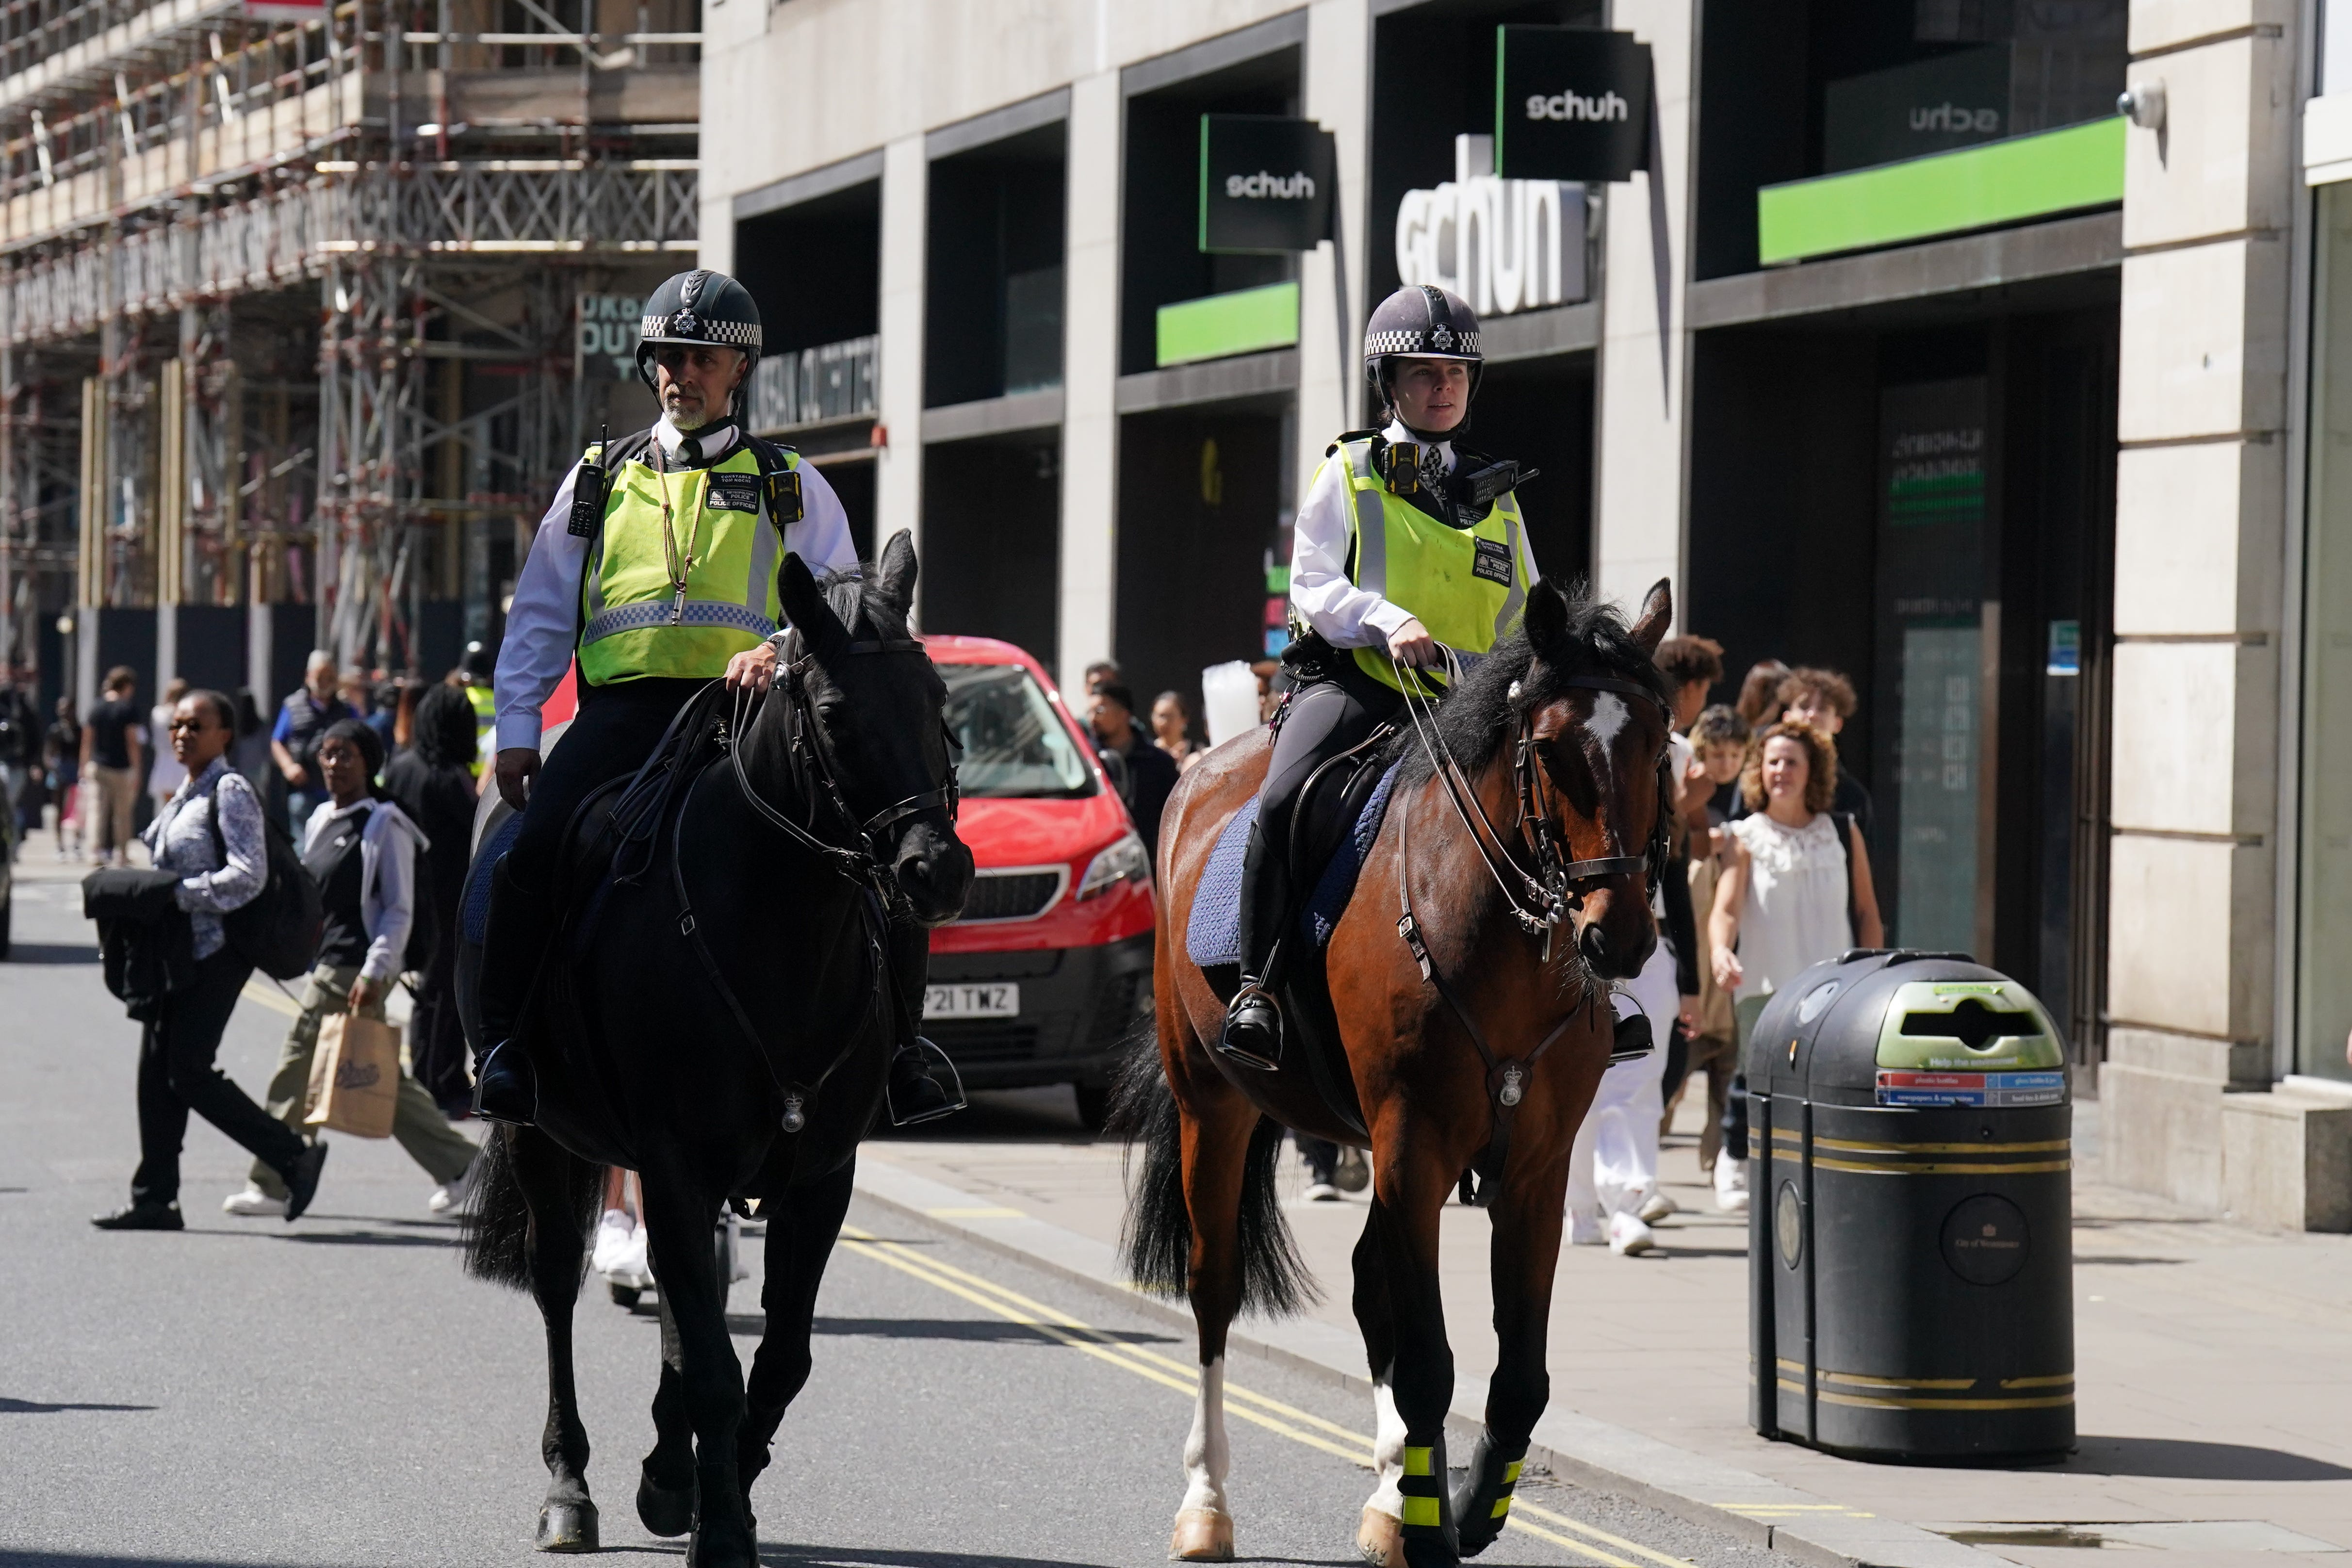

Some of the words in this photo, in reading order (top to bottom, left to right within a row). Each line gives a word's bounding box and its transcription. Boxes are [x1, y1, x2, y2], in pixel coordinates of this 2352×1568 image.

[1526, 89, 1628, 121] schuh
[1225, 170, 1315, 199] schuh
[732, 501, 755, 509] OFFICER
[1476, 567, 1493, 576] POLICE
[1494, 572, 1509, 582] OFFICER
[1493, 563, 1506, 572] POLICE
[963, 988, 1007, 1010] TWZ
[1929, 1057, 1952, 1068] Help
[1954, 1058, 1969, 1066] the
